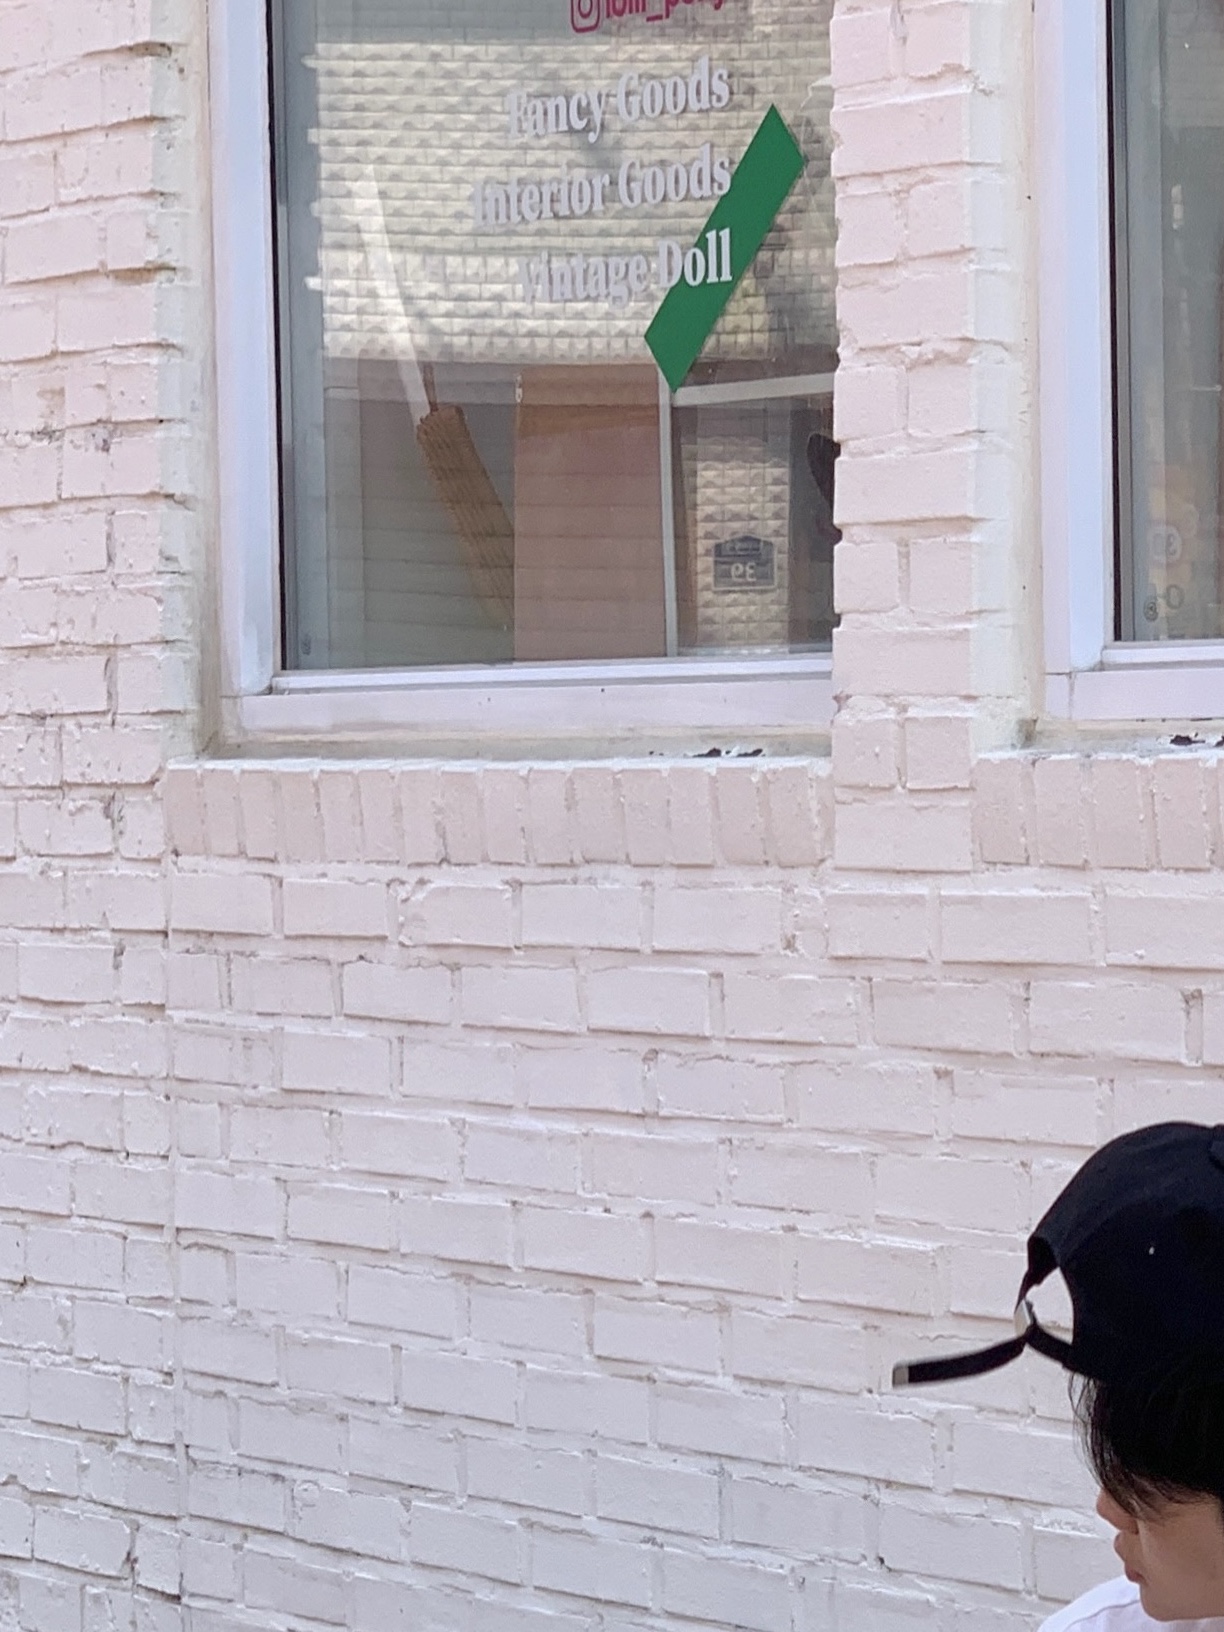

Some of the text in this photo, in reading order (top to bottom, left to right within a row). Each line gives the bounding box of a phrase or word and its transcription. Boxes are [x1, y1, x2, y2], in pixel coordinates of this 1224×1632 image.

[506, 55, 730, 143] Fancy Goods
[470, 142, 731, 228] Interior Goods
[518, 227, 733, 308] Vintage Doll
